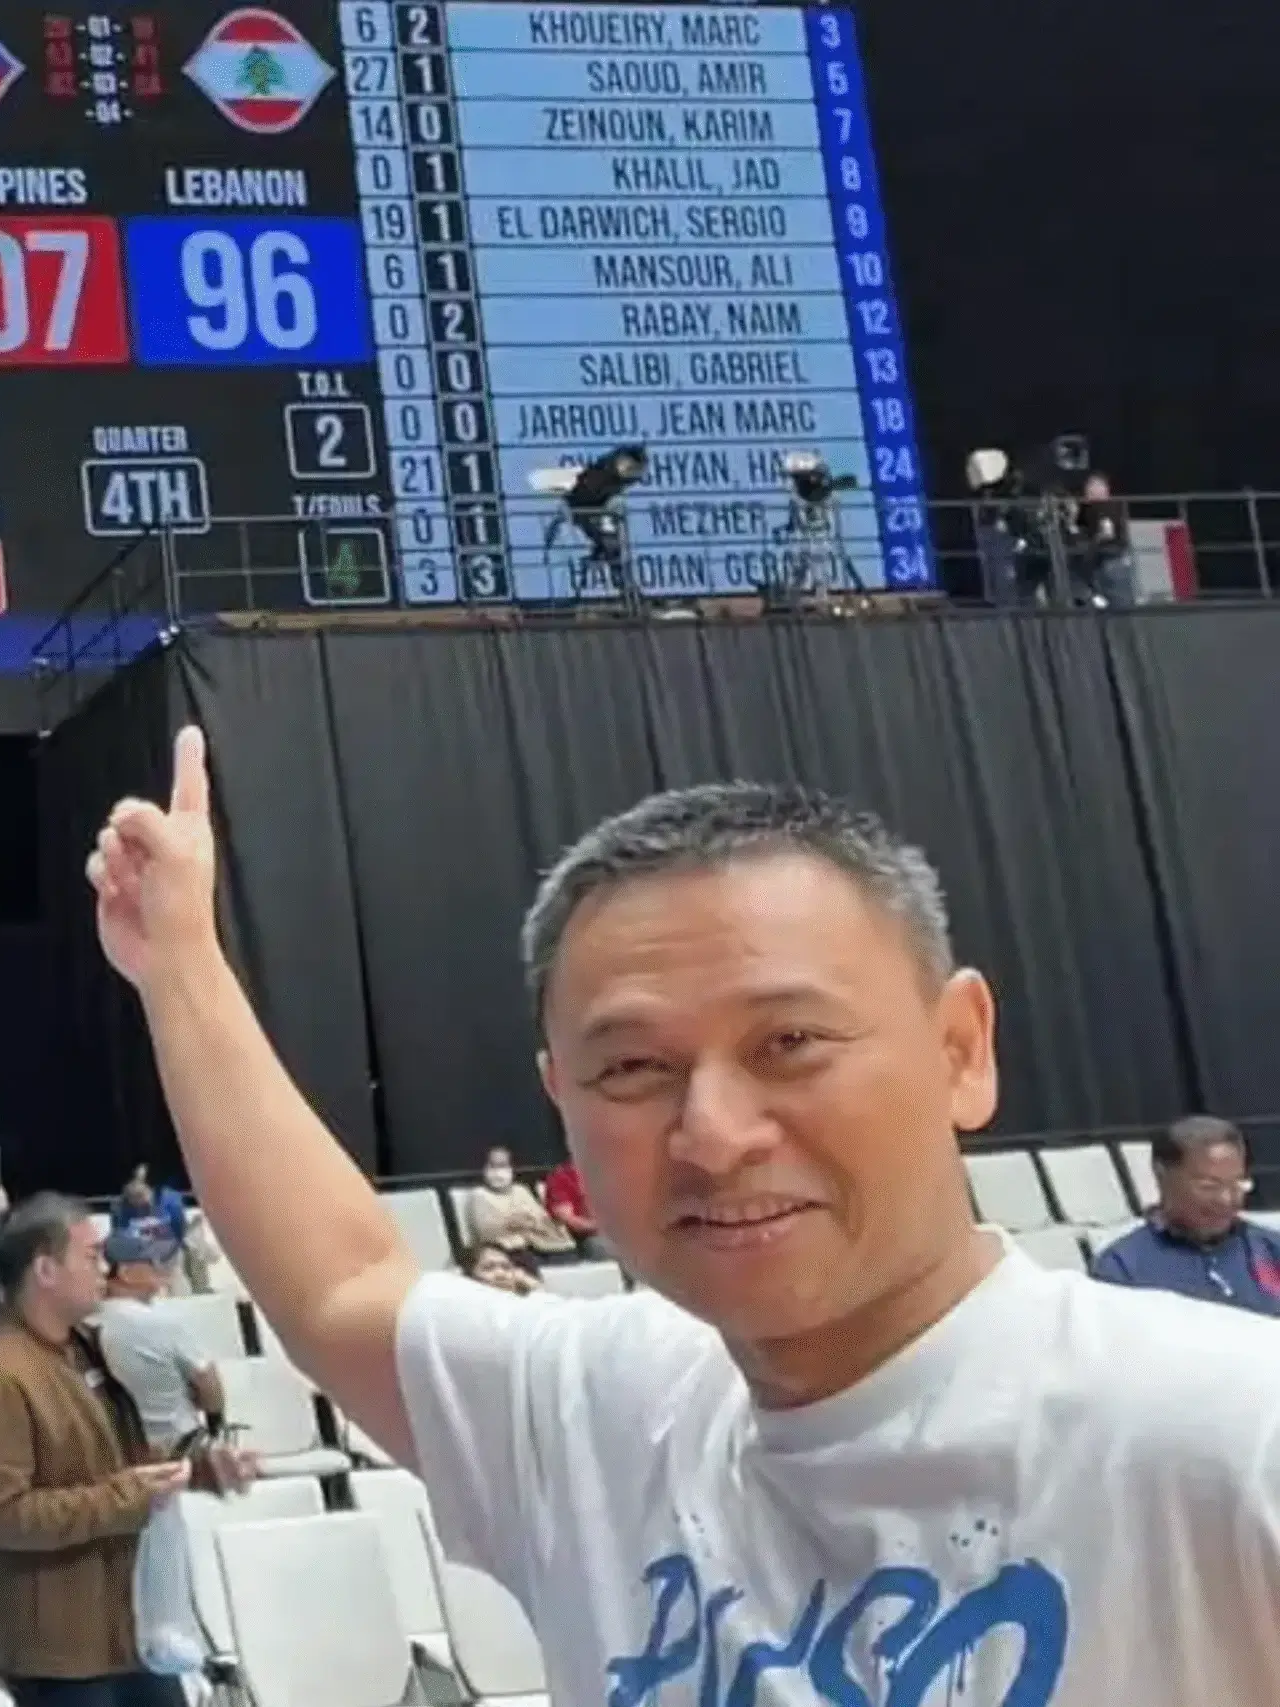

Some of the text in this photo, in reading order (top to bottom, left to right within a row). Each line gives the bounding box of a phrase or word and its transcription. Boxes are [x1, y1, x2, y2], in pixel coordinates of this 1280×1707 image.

[355, 7, 841, 48] 6 2 KHOUEIRY, MARC 3
[352, 60, 389, 95] 27
[415, 56, 436, 92] 1
[587, 60, 689, 96] SAOUD,
[698, 61, 768, 93] AMIR
[357, 105, 853, 147] 14 0 ZEINOUN, KARIM 7
[164, 167, 308, 207] LEBANON
[371, 154, 861, 196] 0 1 KHALIL, JAD 8
[369, 205, 406, 240] 19
[431, 204, 451, 240] 1
[498, 205, 532, 239] EL
[541, 204, 679, 242] DARWICH,
[686, 205, 787, 239] SERGIO
[180, 229, 318, 352] 96
[385, 252, 884, 292] 6 1 MANSOUR, ALI 10
[389, 300, 893, 344] 0 2 RABAY, NAIM 12
[395, 348, 898, 391] 0 0 SALIBI, GABRIEL 13
[92, 425, 189, 454] QUARTER
[314, 413, 348, 468] 2
[401, 398, 906, 442] 0 0 JARROUJ, JEAN MARC 18
[400, 454, 436, 493] 21
[461, 453, 480, 492] 1
[875, 446, 915, 484] 24
[101, 468, 194, 525] 4TH
[413, 507, 434, 545] 0
[472, 505, 488, 543] 1
[418, 557, 439, 597] 3
[471, 555, 497, 596] 3
[890, 544, 929, 582] 34
